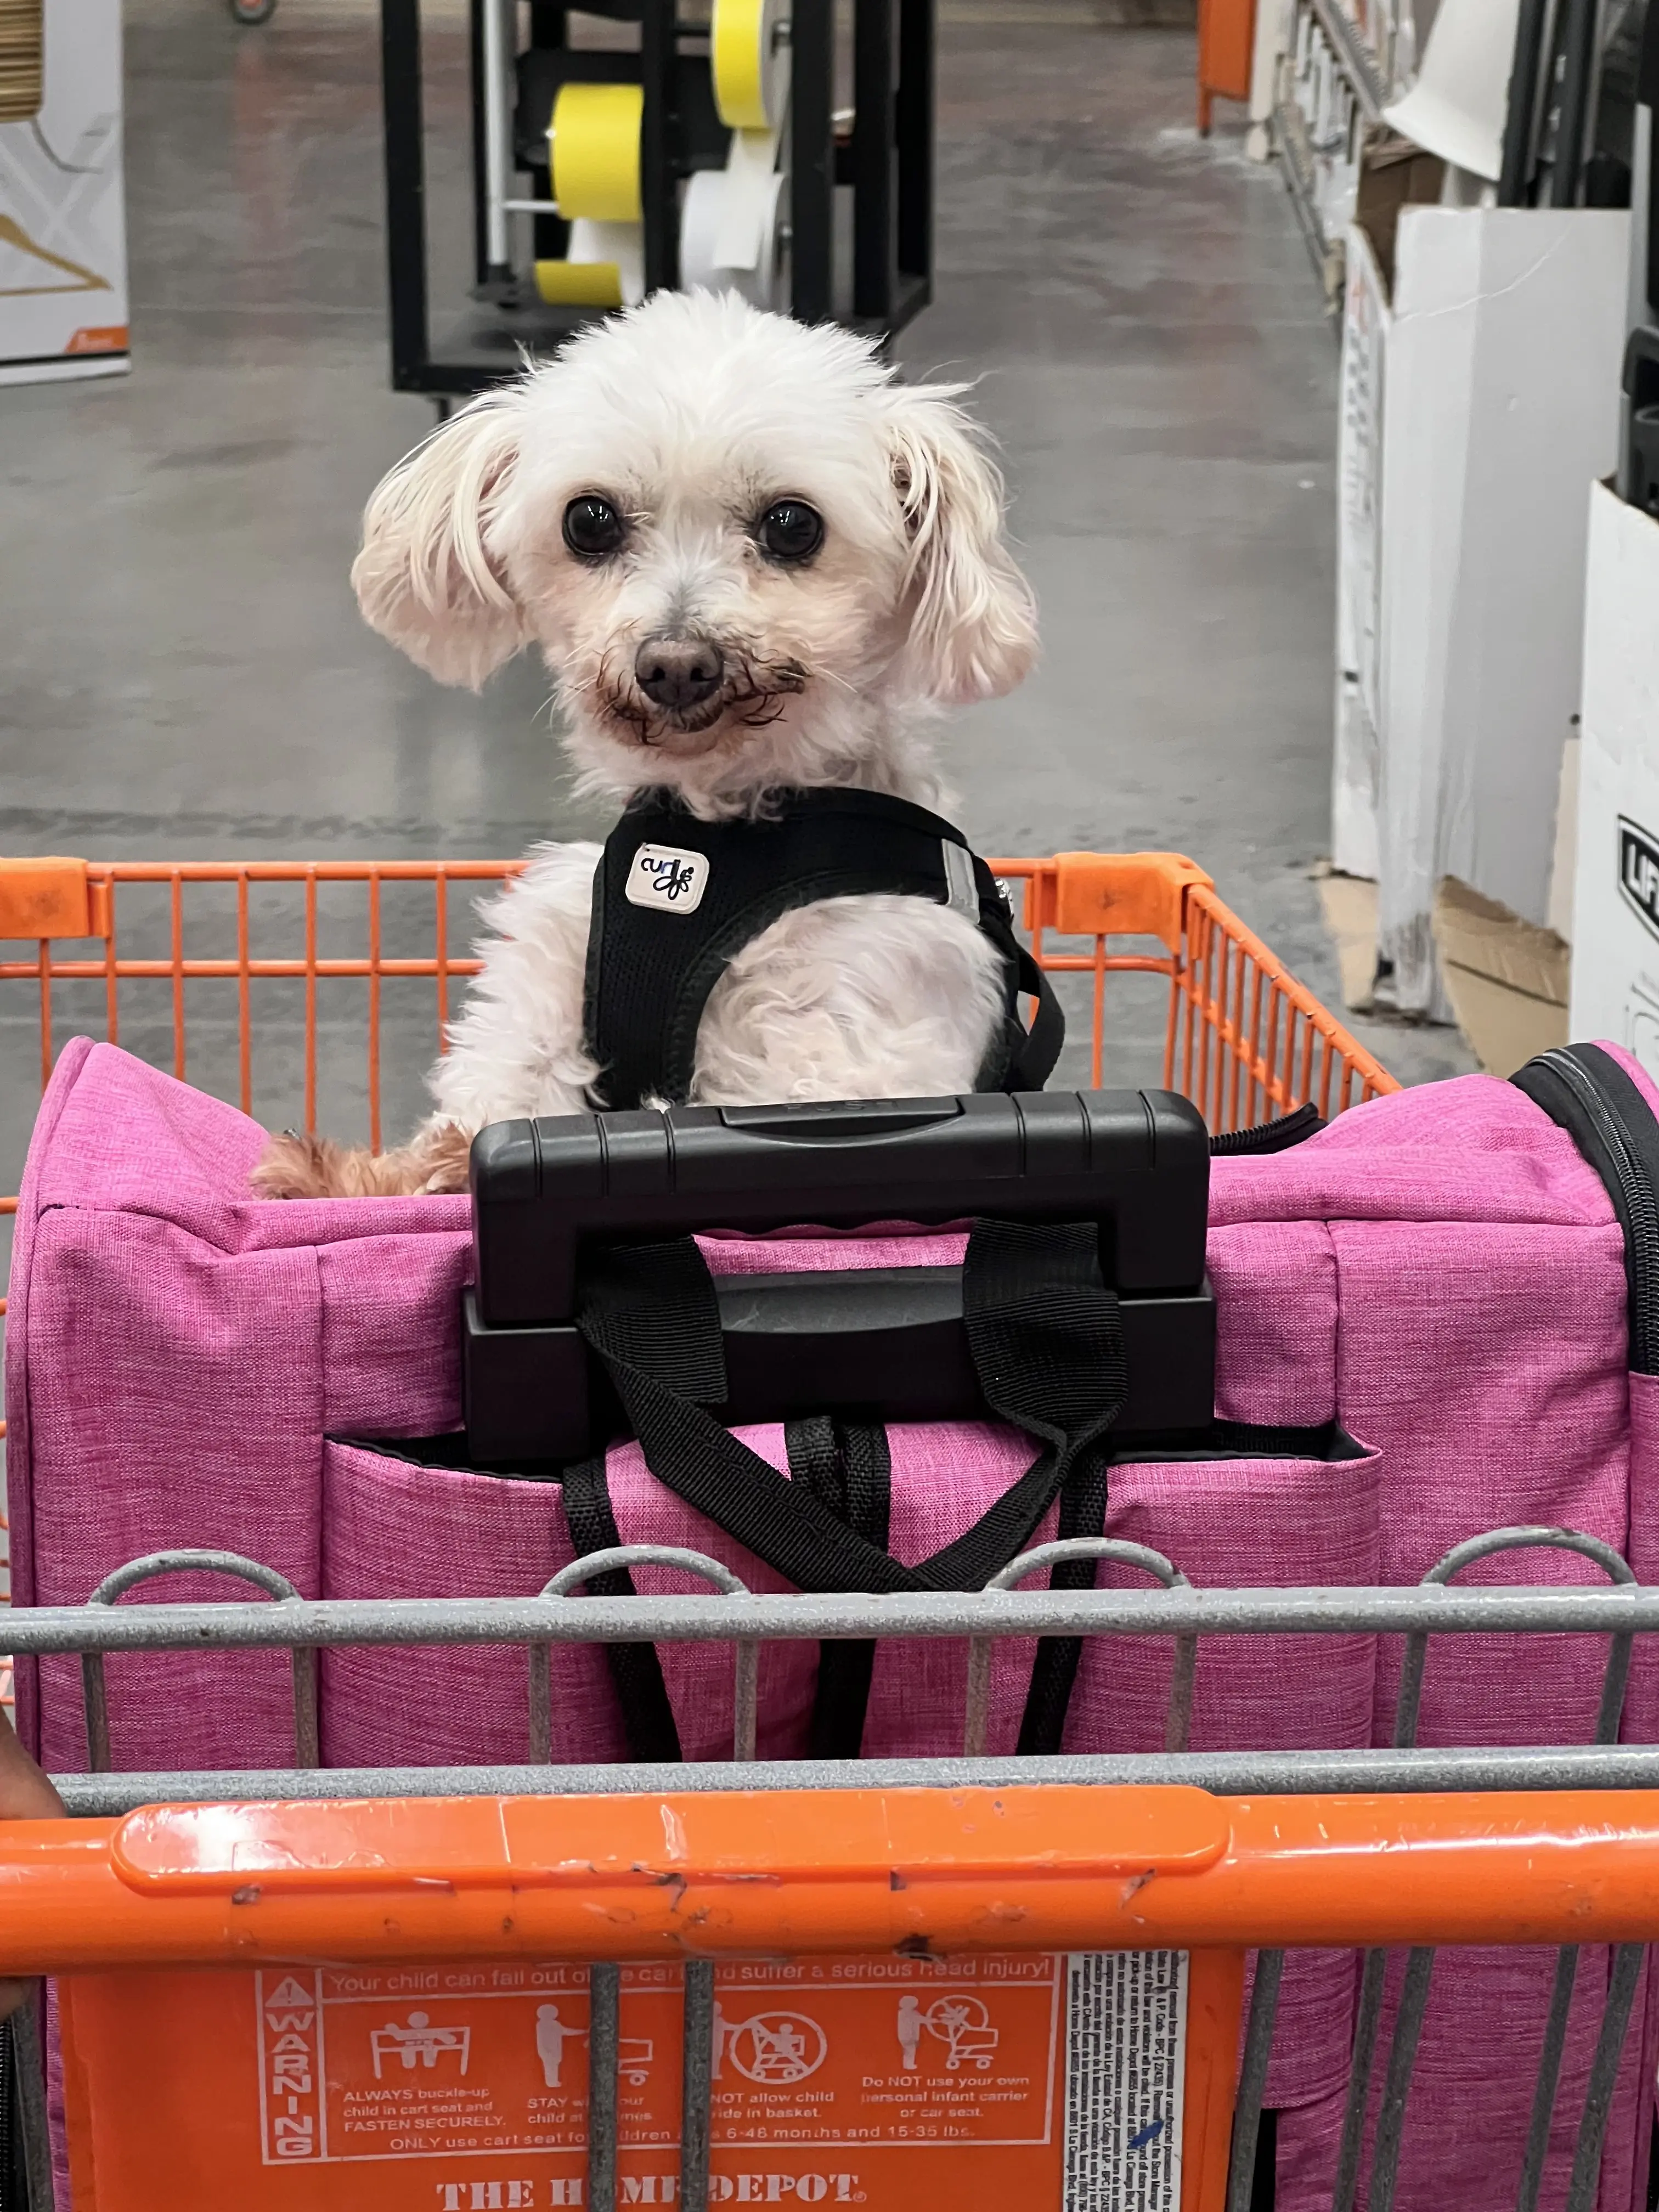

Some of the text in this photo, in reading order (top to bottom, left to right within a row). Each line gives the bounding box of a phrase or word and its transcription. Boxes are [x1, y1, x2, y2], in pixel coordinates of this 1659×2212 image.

[332, 1976, 380, 1991] Your
[387, 1972, 437, 1989] child
[445, 1972, 485, 1987] can
[493, 1969, 524, 1985] fall
[532, 1967, 566, 1984] out
[832, 1961, 912, 1978] serious
[983, 1957, 1049, 1979] injury!
[266, 2011, 314, 2156] WARNING
[862, 2076, 1029, 2089] Do NOT use your own
[343, 2090, 413, 2103] ALWAYS
[749, 2092, 792, 2103] allow
[795, 2091, 834, 2102] child
[933, 2090, 975, 2102] infant
[979, 2090, 1030, 2102] carrier
[343, 2101, 493, 2118] child in cart seat and
[528, 2098, 568, 2109] STAY
[528, 2113, 563, 2124] child
[747, 2109, 761, 2118] in
[766, 2108, 821, 2118] basket.
[900, 2107, 984, 2118] or car seat.
[345, 2116, 506, 2132] FASTEN SECURELY.
[390, 2138, 441, 2150] ONLY
[446, 2137, 477, 2147] use
[483, 2136, 518, 2146] cart
[524, 2133, 562, 2145] seat
[568, 2132, 589, 2143] fo
[727, 2128, 767, 2138] 6-48
[774, 2127, 840, 2138] months
[847, 2126, 879, 2137] and
[888, 2126, 936, 2137] 15-35
[944, 2125, 975, 2137] lbs.
[437, 2180, 534, 2211] THE
[550, 2176, 681, 2205] HME
